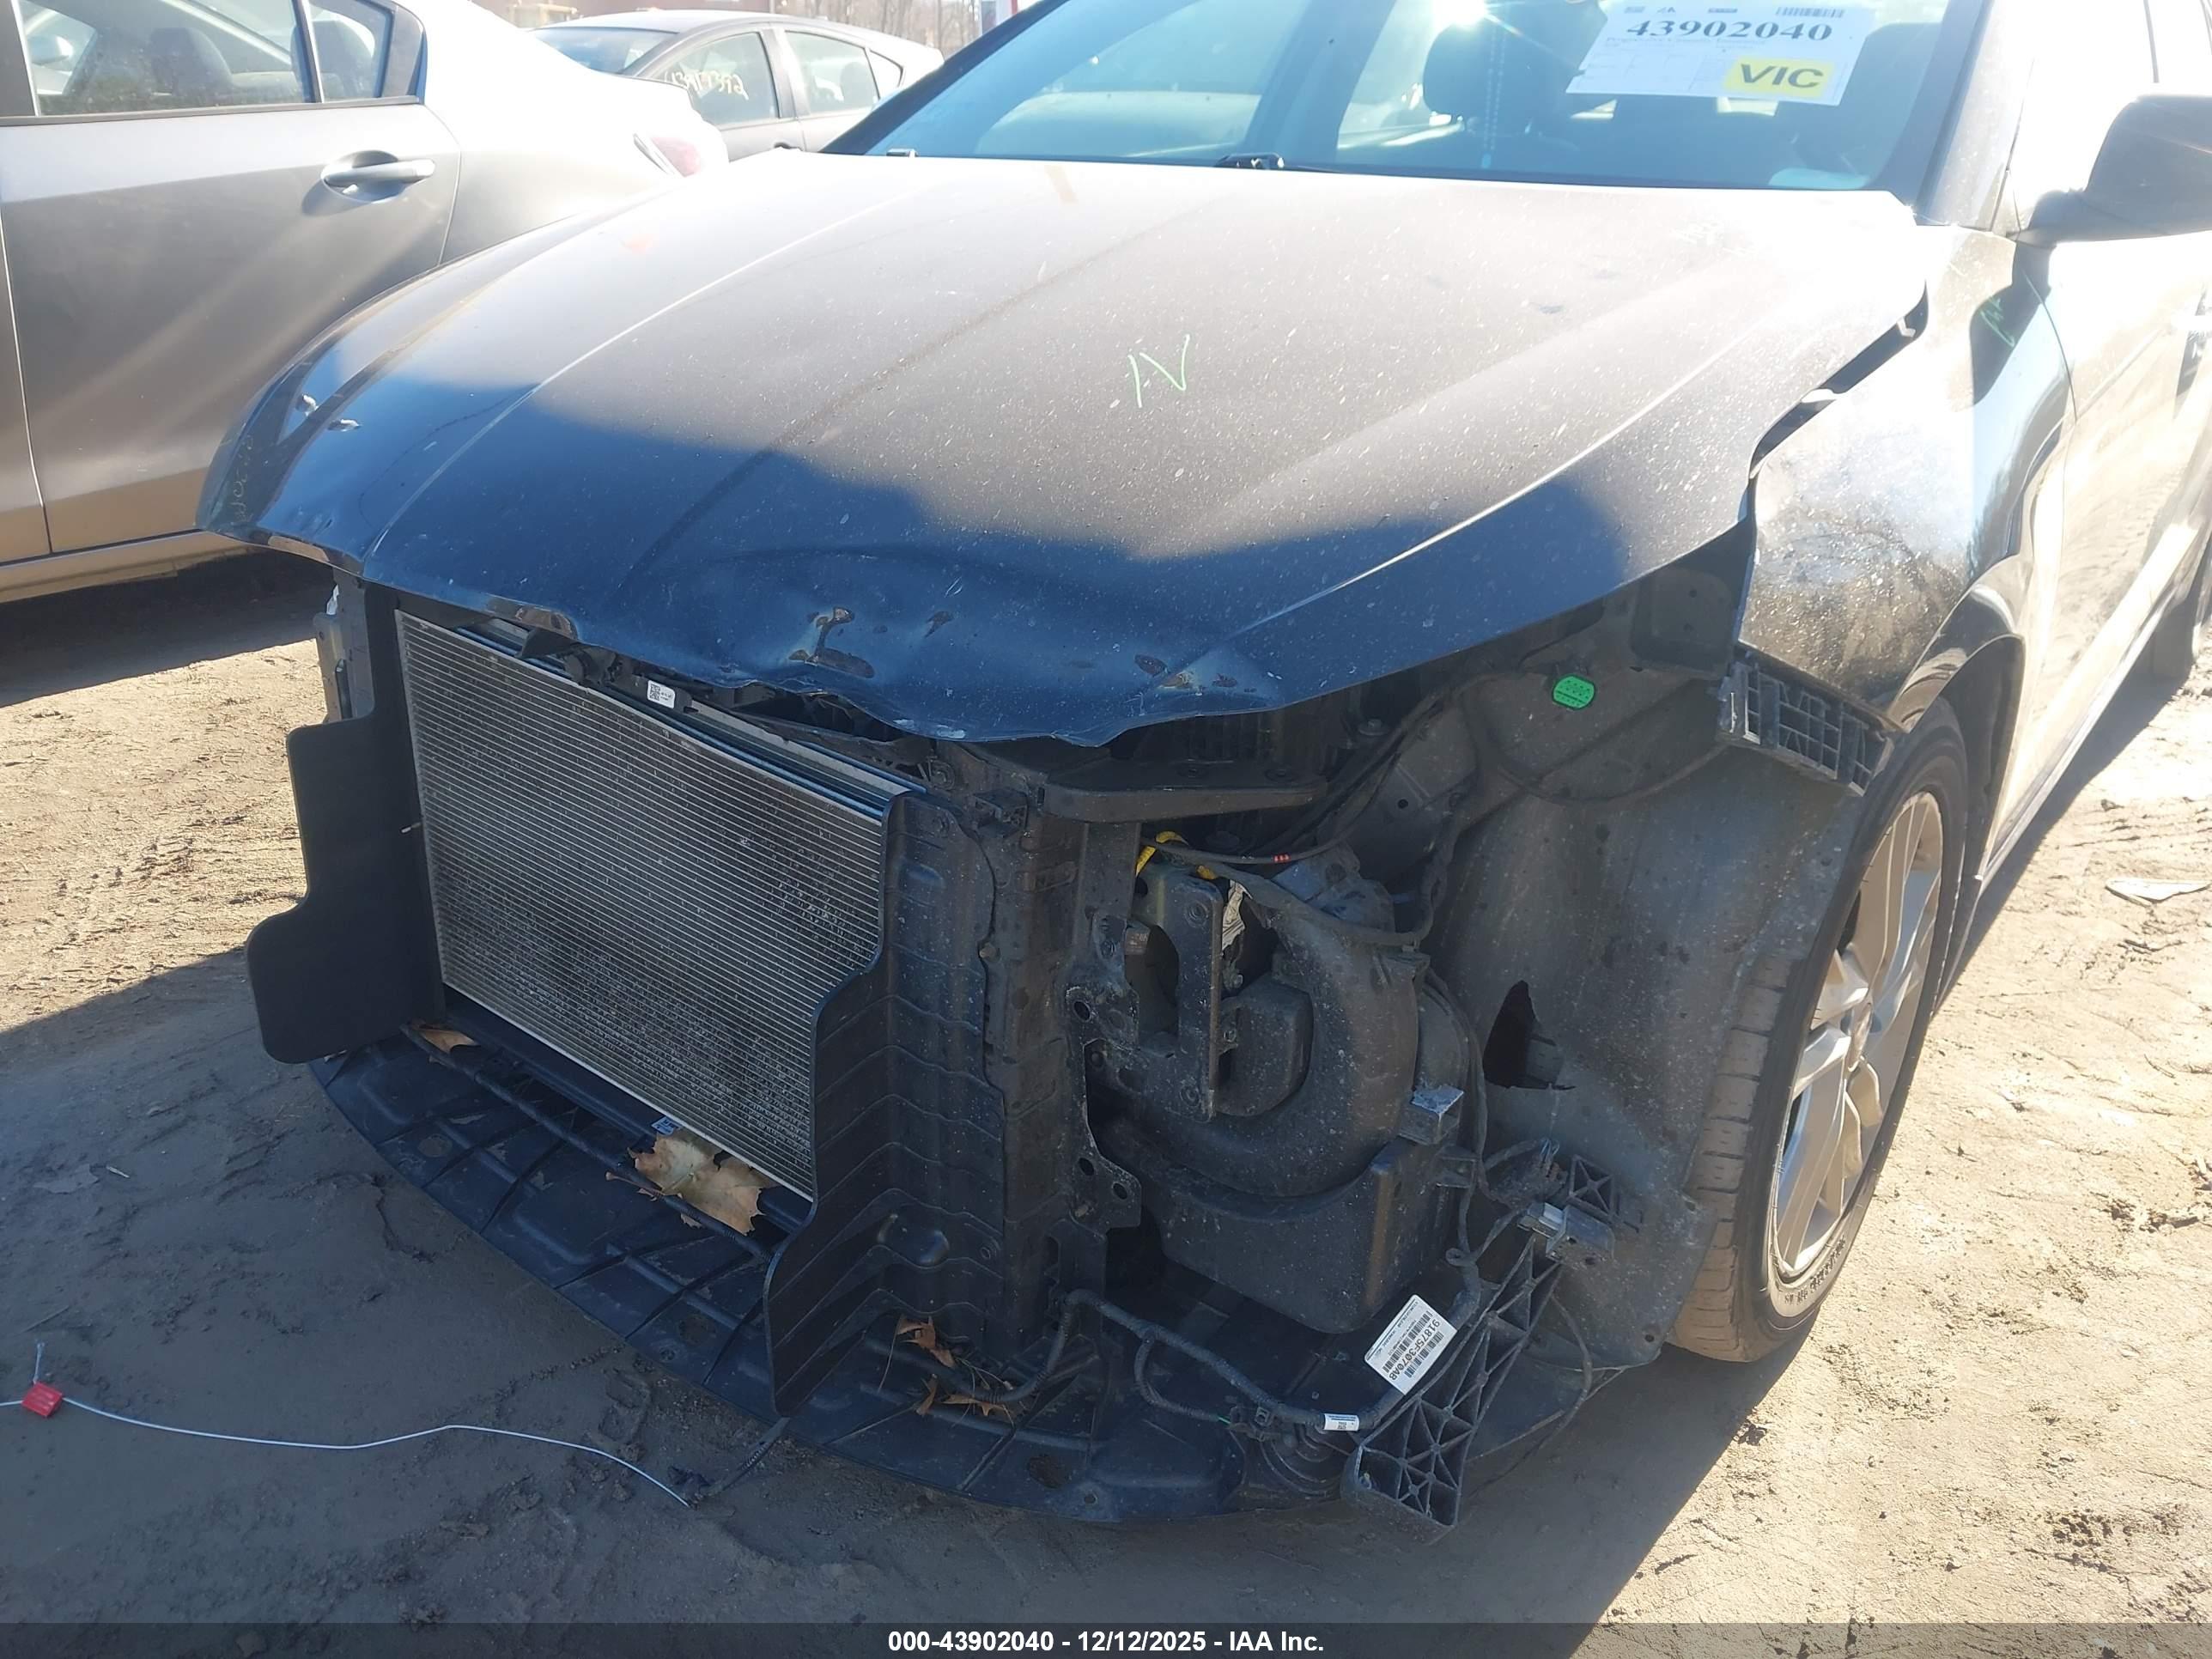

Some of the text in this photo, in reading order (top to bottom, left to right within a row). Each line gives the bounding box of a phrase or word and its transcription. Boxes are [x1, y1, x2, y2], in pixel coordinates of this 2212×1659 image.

[1626, 19, 1833, 41] 43902040
[1741, 64, 1825, 89] VIC
[1389, 1318, 1440, 1381] 91875F3070AB
